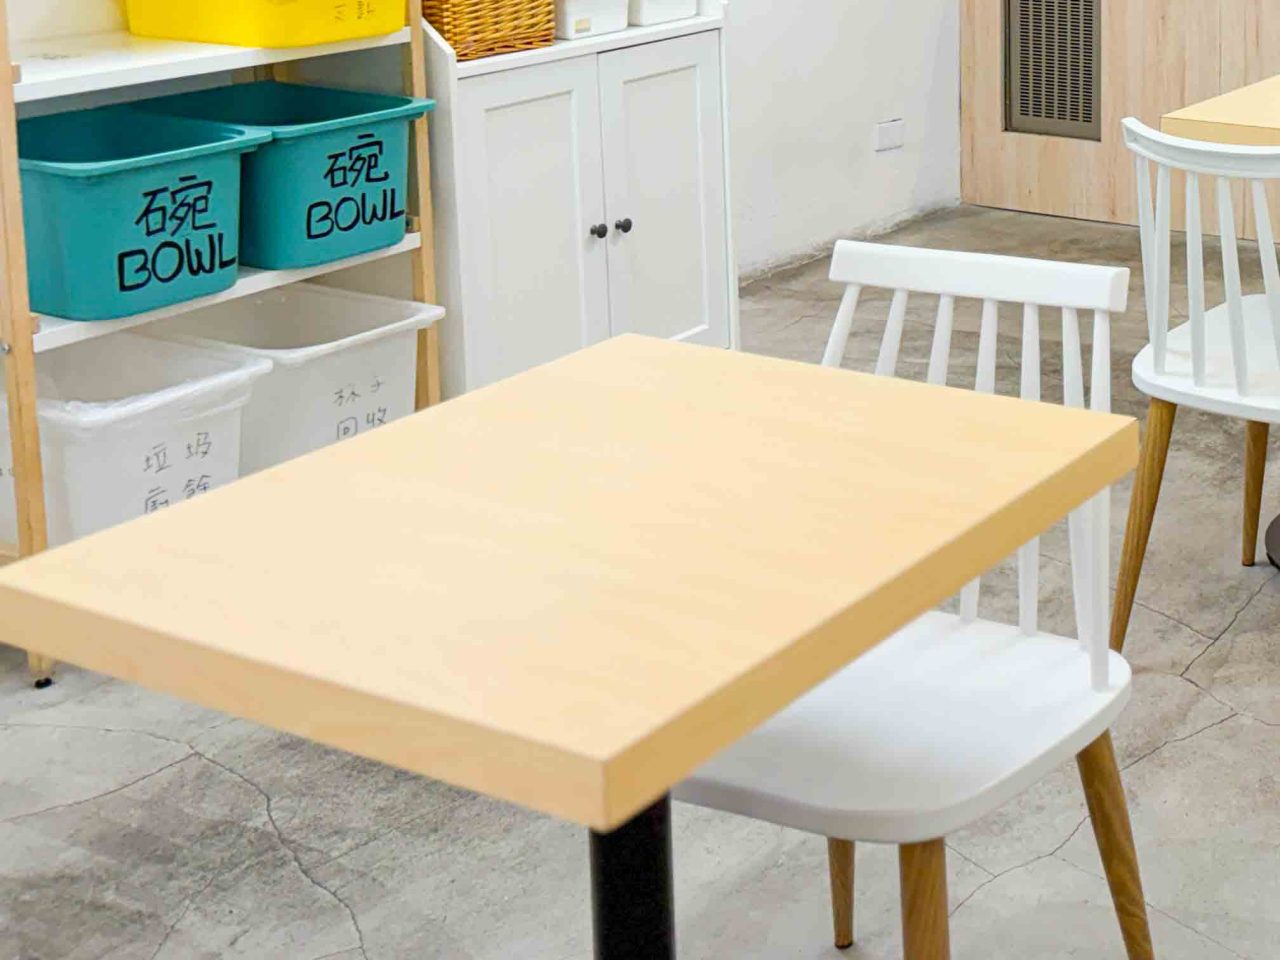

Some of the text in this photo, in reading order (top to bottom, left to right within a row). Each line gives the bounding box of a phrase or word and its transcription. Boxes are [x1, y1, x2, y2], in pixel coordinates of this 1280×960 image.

[323, 133, 390, 189] 碗
[135, 174, 218, 238] 碗
[306, 188, 405, 240] BOWL
[118, 232, 237, 293] BOWL
[143, 432, 213, 474] 垃圾
